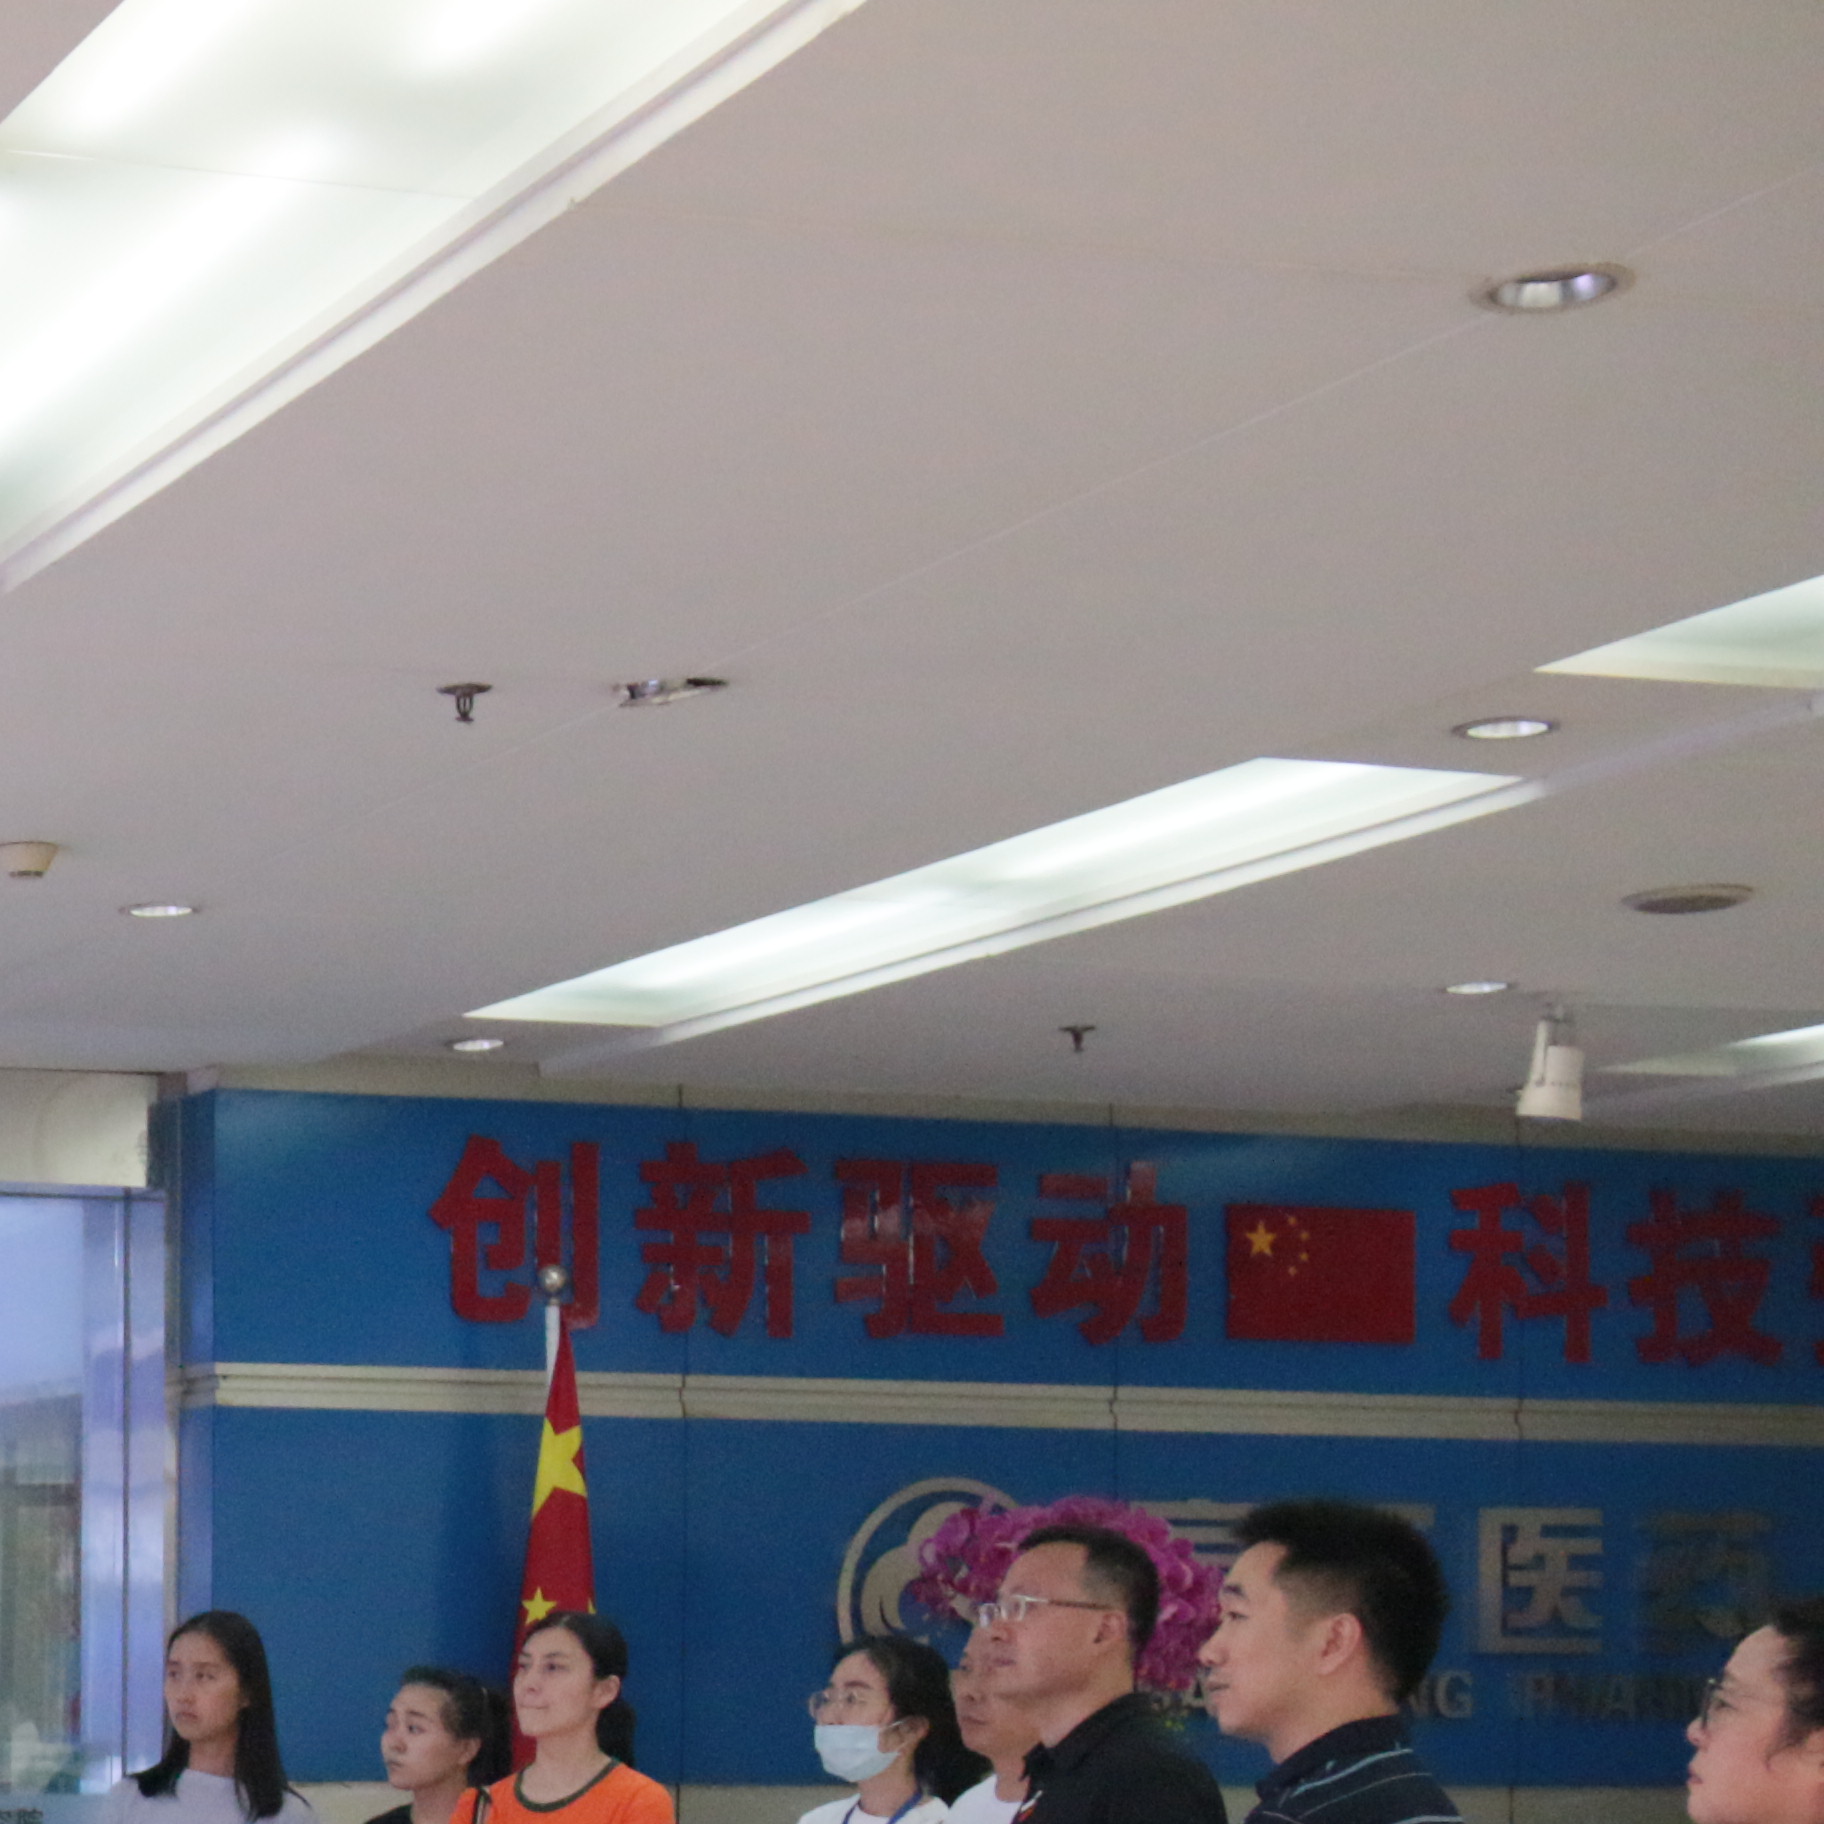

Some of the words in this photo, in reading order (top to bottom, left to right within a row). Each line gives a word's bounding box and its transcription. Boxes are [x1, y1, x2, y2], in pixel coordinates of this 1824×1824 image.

[429, 1133, 1189, 1346] 创新驱动
[1448, 1180, 1824, 1364] 科技
